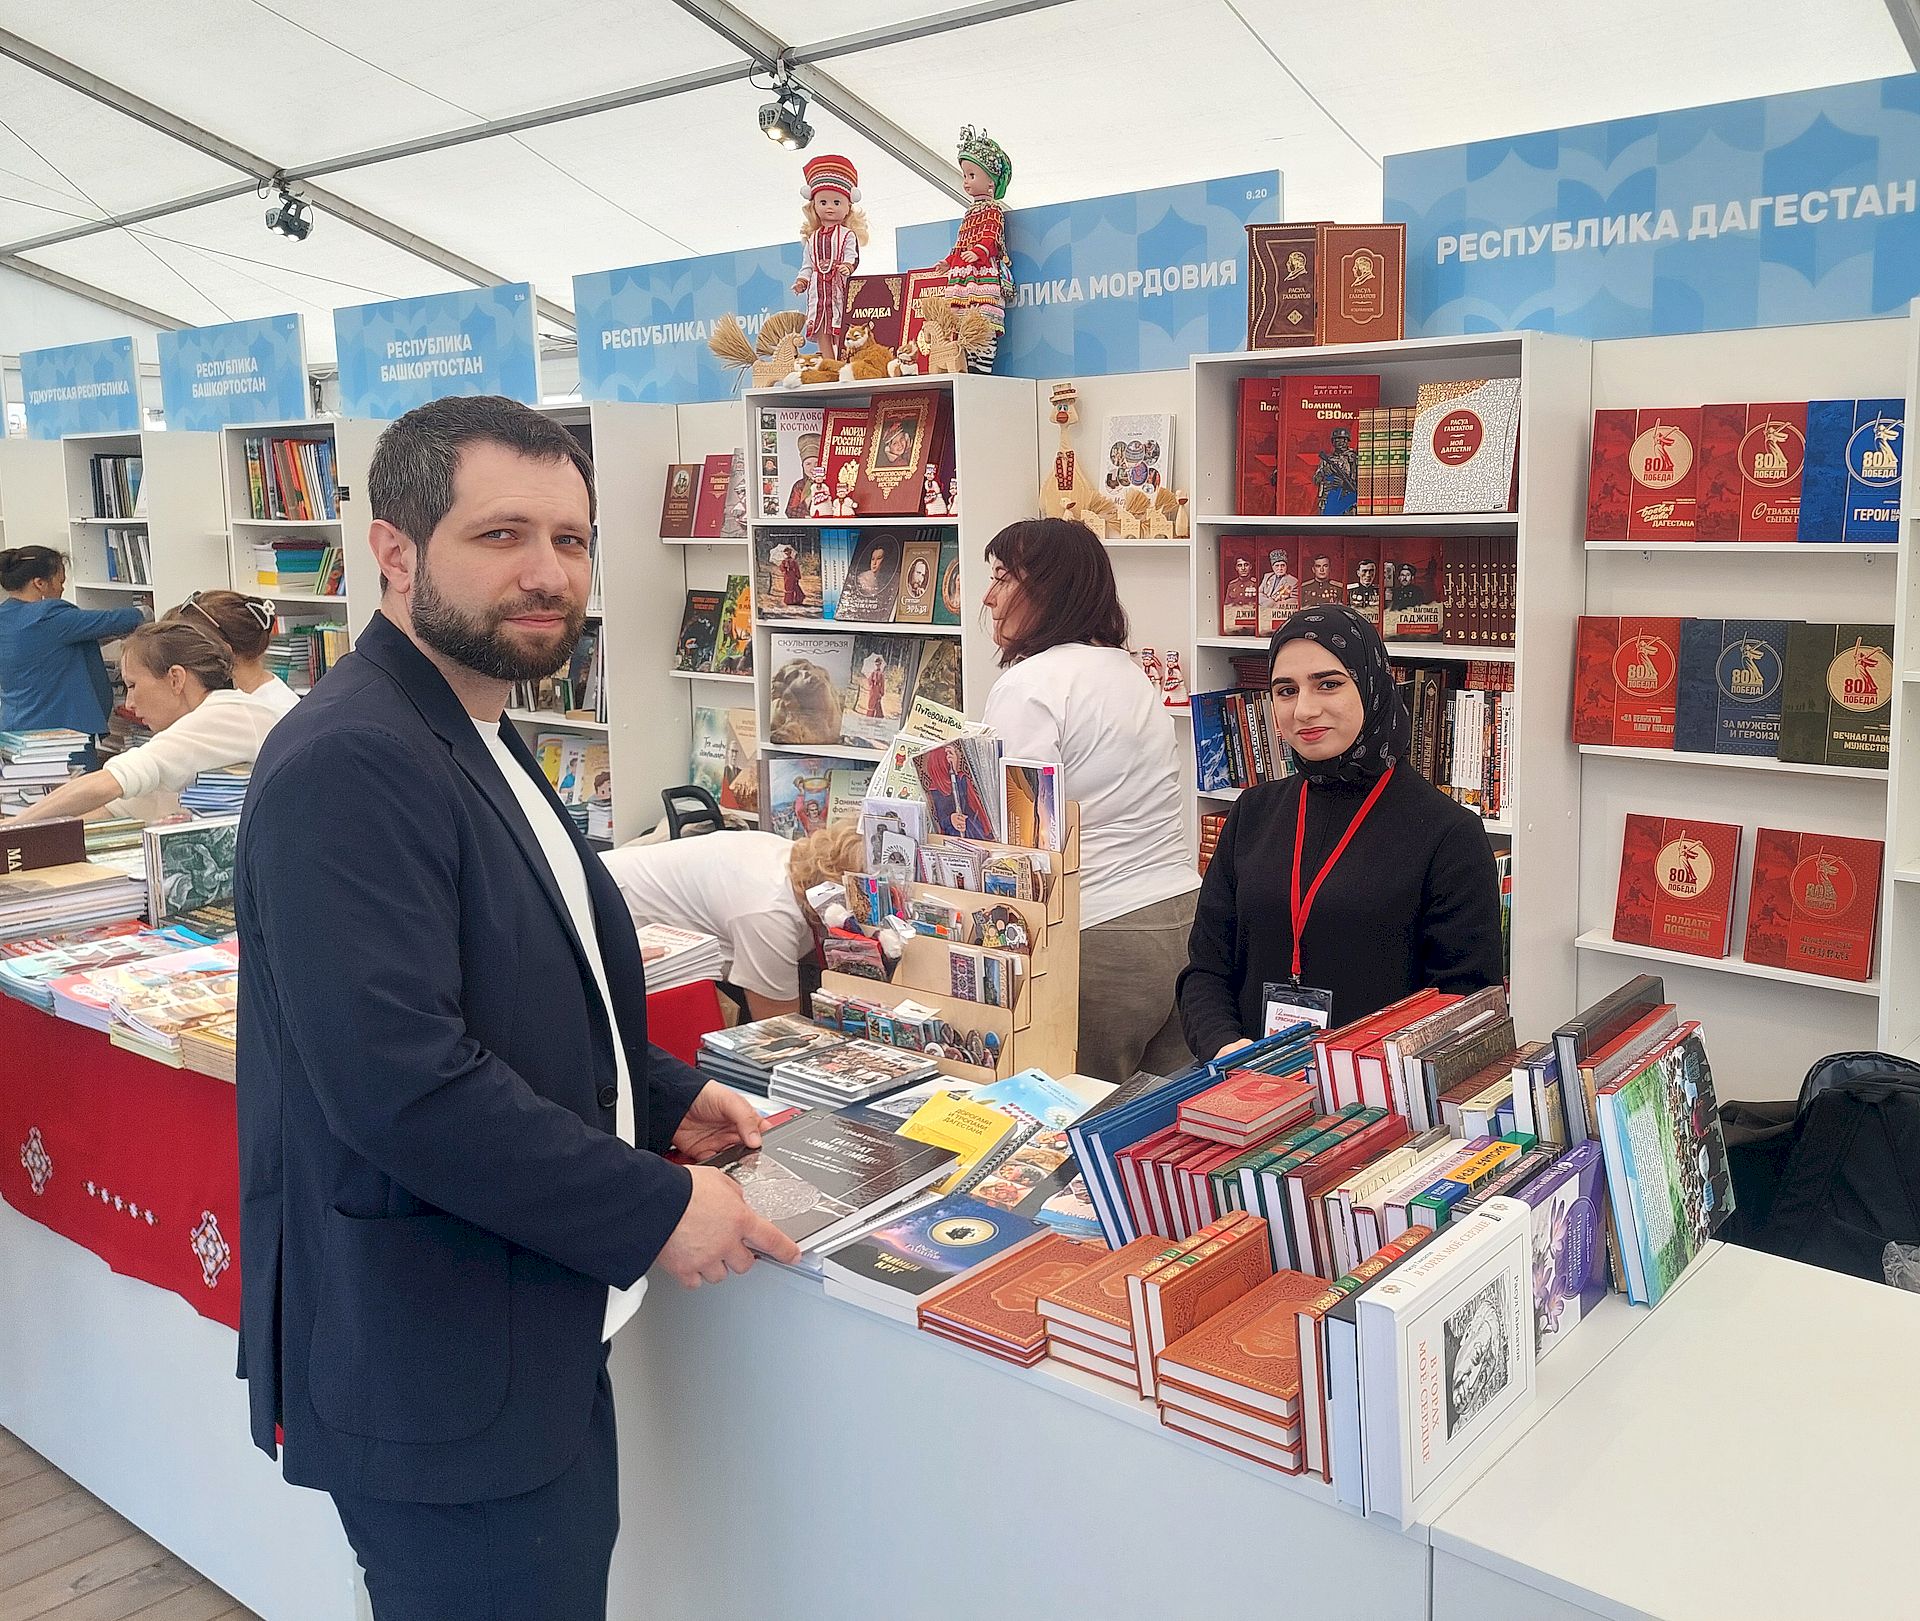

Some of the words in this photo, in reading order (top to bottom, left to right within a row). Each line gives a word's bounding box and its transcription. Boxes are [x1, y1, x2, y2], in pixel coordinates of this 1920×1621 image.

[1246, 188, 1268, 200] 8.20
[1437, 209, 1679, 265] РЕСПУБЛИКА
[1687, 179, 1918, 241] ДАГЕСТАН
[1089, 259, 1238, 300] МОРДОВИЯ
[852, 306, 892, 319] МОРДВА
[602, 319, 707, 350] РЕСПУБЛИКА
[387, 333, 472, 359] РЕСПУБЛИКА
[196, 356, 258, 378] РЕСПУБЛИКА
[380, 355, 483, 382] БАШКОРТОСТАН
[28, 384, 78, 405] УДМУРТСКАЯ
[77, 380, 130, 399] РЕСПУБЛИКА
[192, 377, 266, 399] БАШКОРТОСТАН
[1301, 399, 1342, 410] Помним
[779, 410, 824, 422] МОРДОВС
[1449, 418, 1469, 426] РАСУЛ
[780, 422, 819, 432] КОСТЮМ
[1443, 424, 1475, 433] ГАМЗАТОВ
[1449, 438, 1465, 447] МОЙ
[1440, 444, 1473, 454] ДАГЕСТАН
[1644, 457, 1661, 471] 80
[1754, 451, 1772, 468] 80
[1862, 450, 1882, 468] 80
[1643, 472, 1674, 482] ПОБЕДА!
[1753, 470, 1788, 480] ПОБЕДА!
[1861, 468, 1898, 479] ПОБЕДА!
[1652, 520, 1695, 528] ДАГЕСТАНА
[1400, 614, 1439, 623] ГАДЖИЕВ
[1445, 630, 1452, 638] 1
[1458, 631, 1466, 639] 2
[1470, 631, 1478, 639] 3
[1481, 631, 1489, 640] 4
[1491, 631, 1498, 640] 5
[1500, 632, 1508, 641] 6
[778, 639, 823, 648] СКУЛЬПТОР
[824, 640, 849, 648] ЭРЬЗЯ
[1627, 664, 1645, 680] 80
[1731, 669, 1750, 685] 80
[1627, 679, 1658, 690] ПОБЕДА!
[1730, 685, 1763, 696] ПОБЕДА!
[1844, 677, 1864, 694] 80
[1843, 694, 1878, 705] ПОБЕДА!
[914, 703, 963, 731] Путеводитель
[1722, 719, 1735, 728] ЗА
[1737, 720, 1781, 731] МУЖЕСТ
[1730, 729, 1737, 738] И
[1833, 731, 1868, 741] ВЕЧНАЯ
[1869, 734, 1890, 743] ПАМ
[1669, 867, 1685, 883] 80
[1667, 883, 1698, 894] ПОБЕДА!
[1664, 914, 1712, 929] СОЛДАТЫ
[955, 1108, 993, 1126] ДОРОГАМИ
[942, 1116, 983, 1136] ДАГЕСТАНА
[1413, 1269, 1425, 1277] В
[1421, 1252, 1448, 1272] ГОРАХ
[1459, 1219, 1491, 1243] СЕРДЦЕ
[1512, 1274, 1520, 1306] Расул
[1513, 1307, 1522, 1362] Гамзатов
[1431, 1355, 1438, 1366] В
[1431, 1371, 1440, 1428] ГОРАХ
[1420, 1389, 1431, 1465] СЕРДЦЕ
